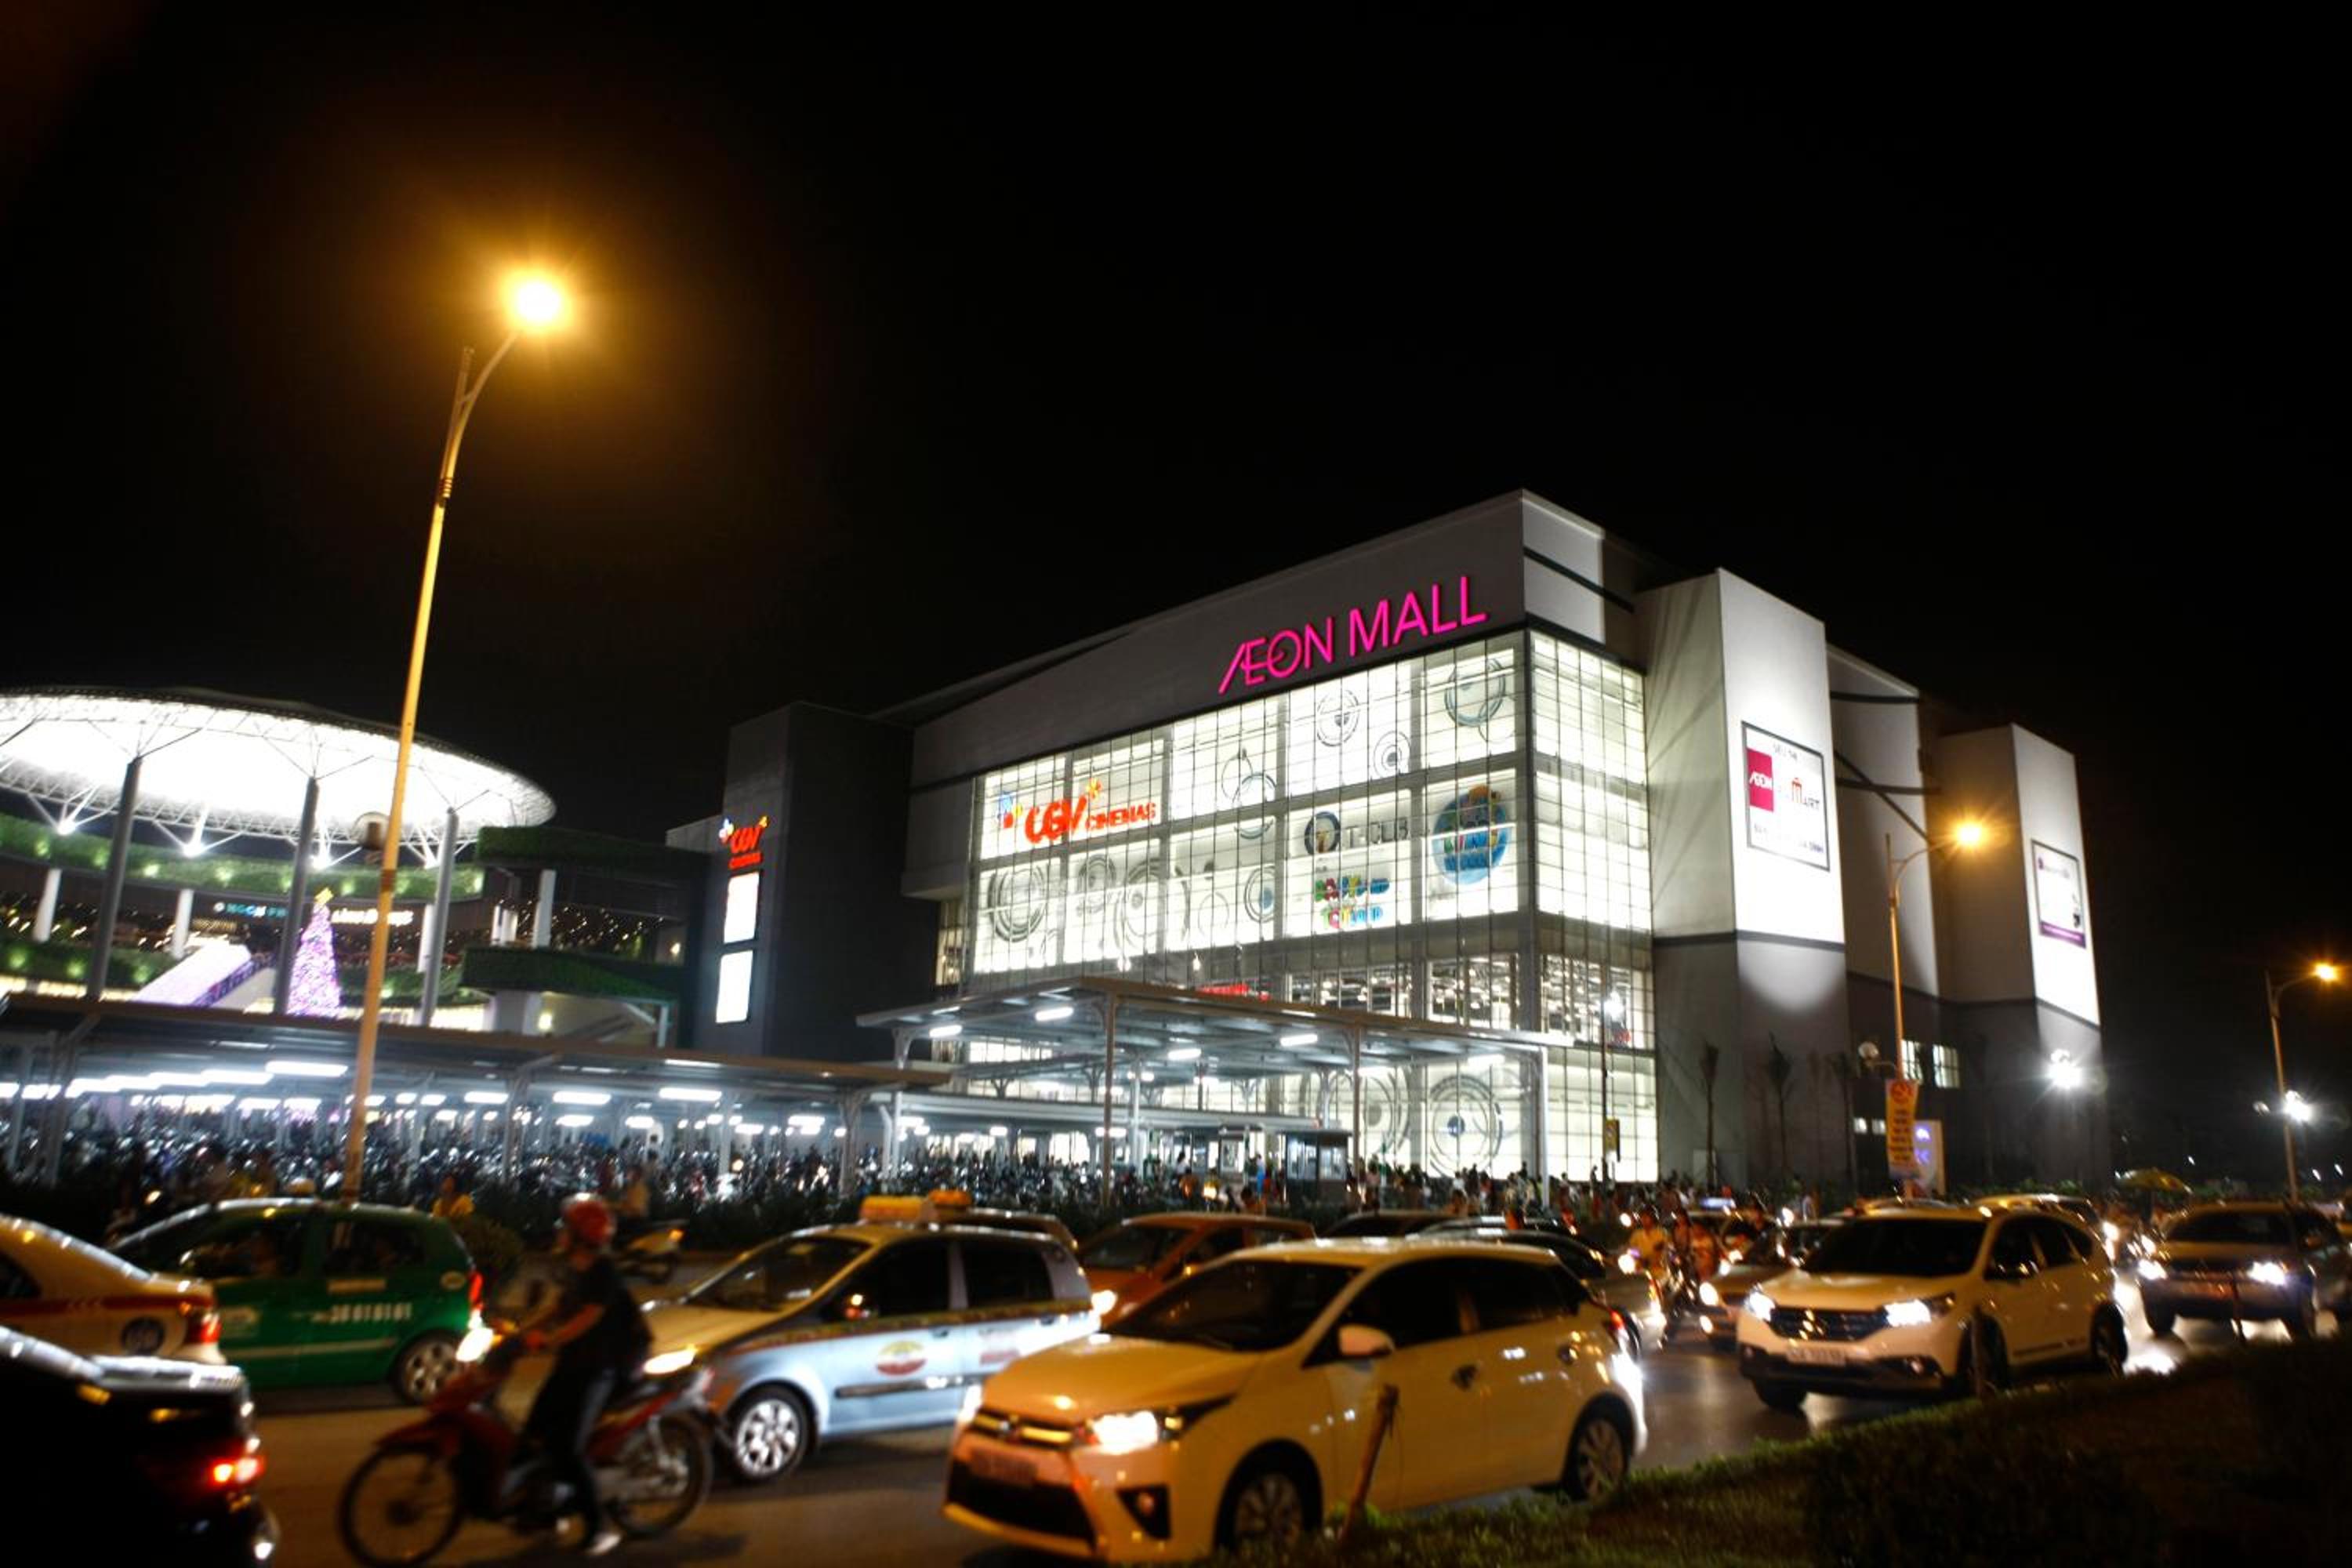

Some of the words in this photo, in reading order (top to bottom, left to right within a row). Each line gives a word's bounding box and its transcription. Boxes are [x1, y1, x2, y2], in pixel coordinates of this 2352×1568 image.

[1348, 575, 1488, 657] MALL
[1025, 795, 1087, 844] CGV
[1085, 801, 1156, 831] CINEMAS
